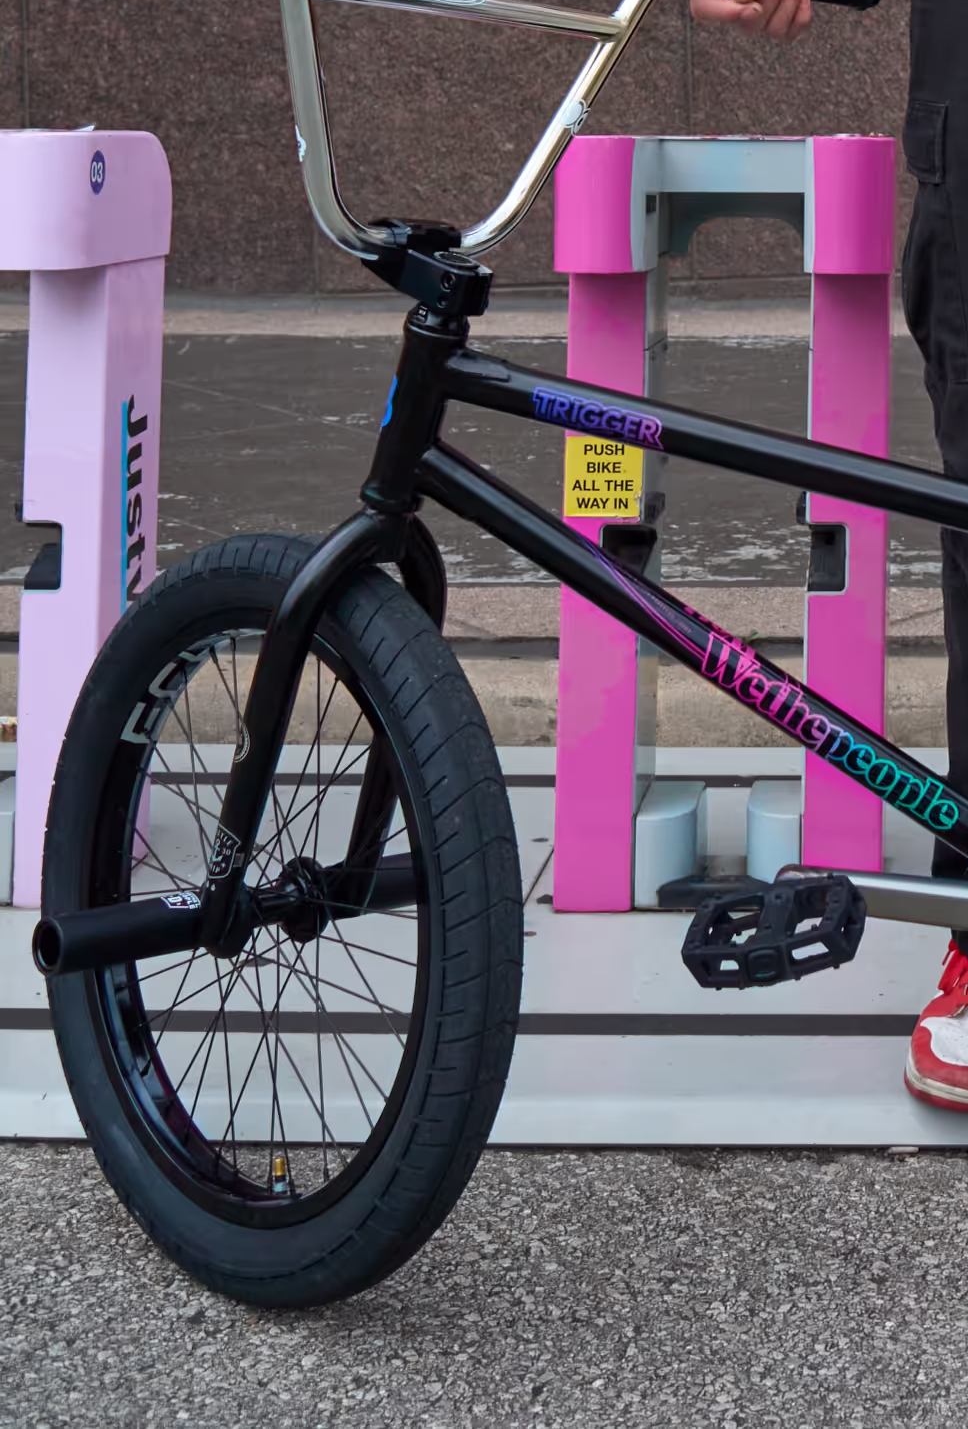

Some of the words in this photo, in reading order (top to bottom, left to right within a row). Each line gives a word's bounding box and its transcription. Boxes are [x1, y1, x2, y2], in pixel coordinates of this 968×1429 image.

[91, 161, 103, 183] 03
[533, 387, 664, 450] TRIGGER
[583, 443, 625, 456] PUSH
[586, 461, 622, 474] BIKE
[572, 479, 600, 492] ALL
[604, 479, 634, 492] THE
[576, 497, 610, 510] WAY
[613, 497, 629, 510] IN
